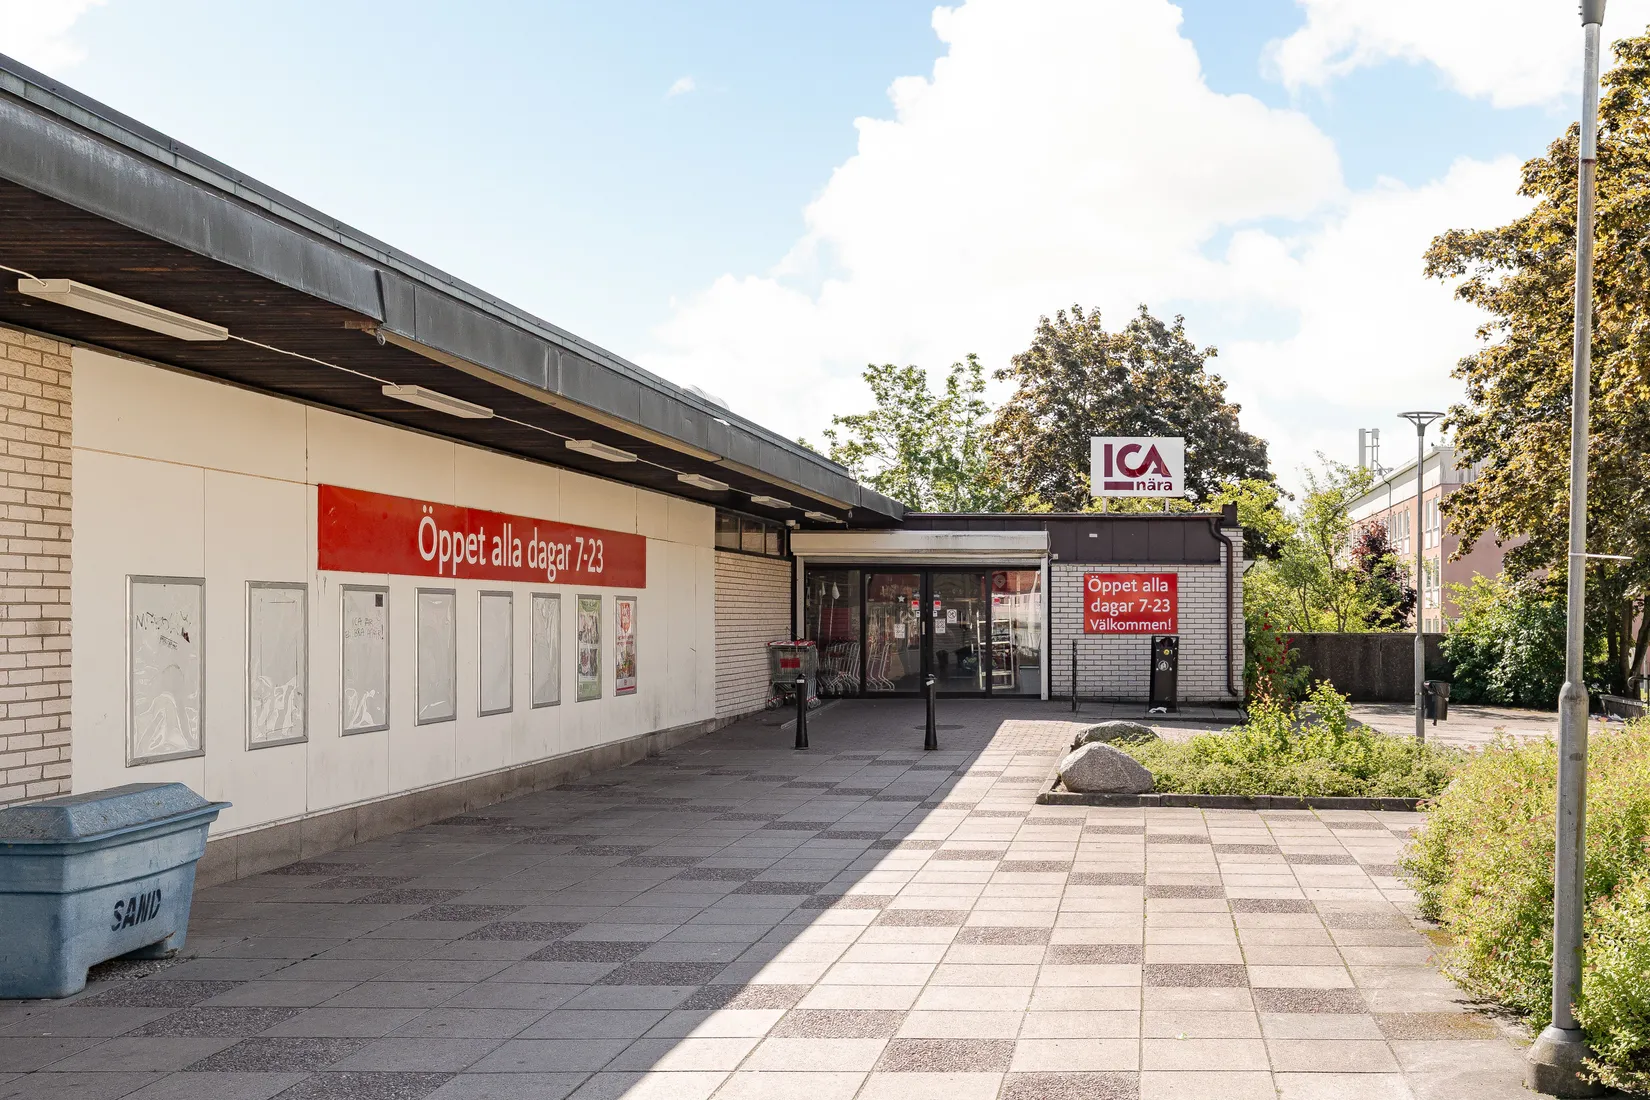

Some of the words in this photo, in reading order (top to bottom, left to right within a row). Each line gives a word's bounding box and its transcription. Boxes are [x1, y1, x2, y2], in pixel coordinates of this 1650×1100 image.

[1103, 443, 1173, 479] ICA
[1136, 478, 1173, 491] nära
[418, 504, 487, 576] Öppet
[491, 522, 522, 568] alla
[527, 526, 572, 583] dagar
[575, 536, 604, 574] 7-23
[1087, 574, 1138, 596] Öppet
[1142, 576, 1169, 593] alla
[1090, 598, 1135, 617] dagar
[1139, 598, 1171, 613] 7-23
[1089, 617, 1172, 631] Välkommen!
[111, 888, 162, 932] SAND
